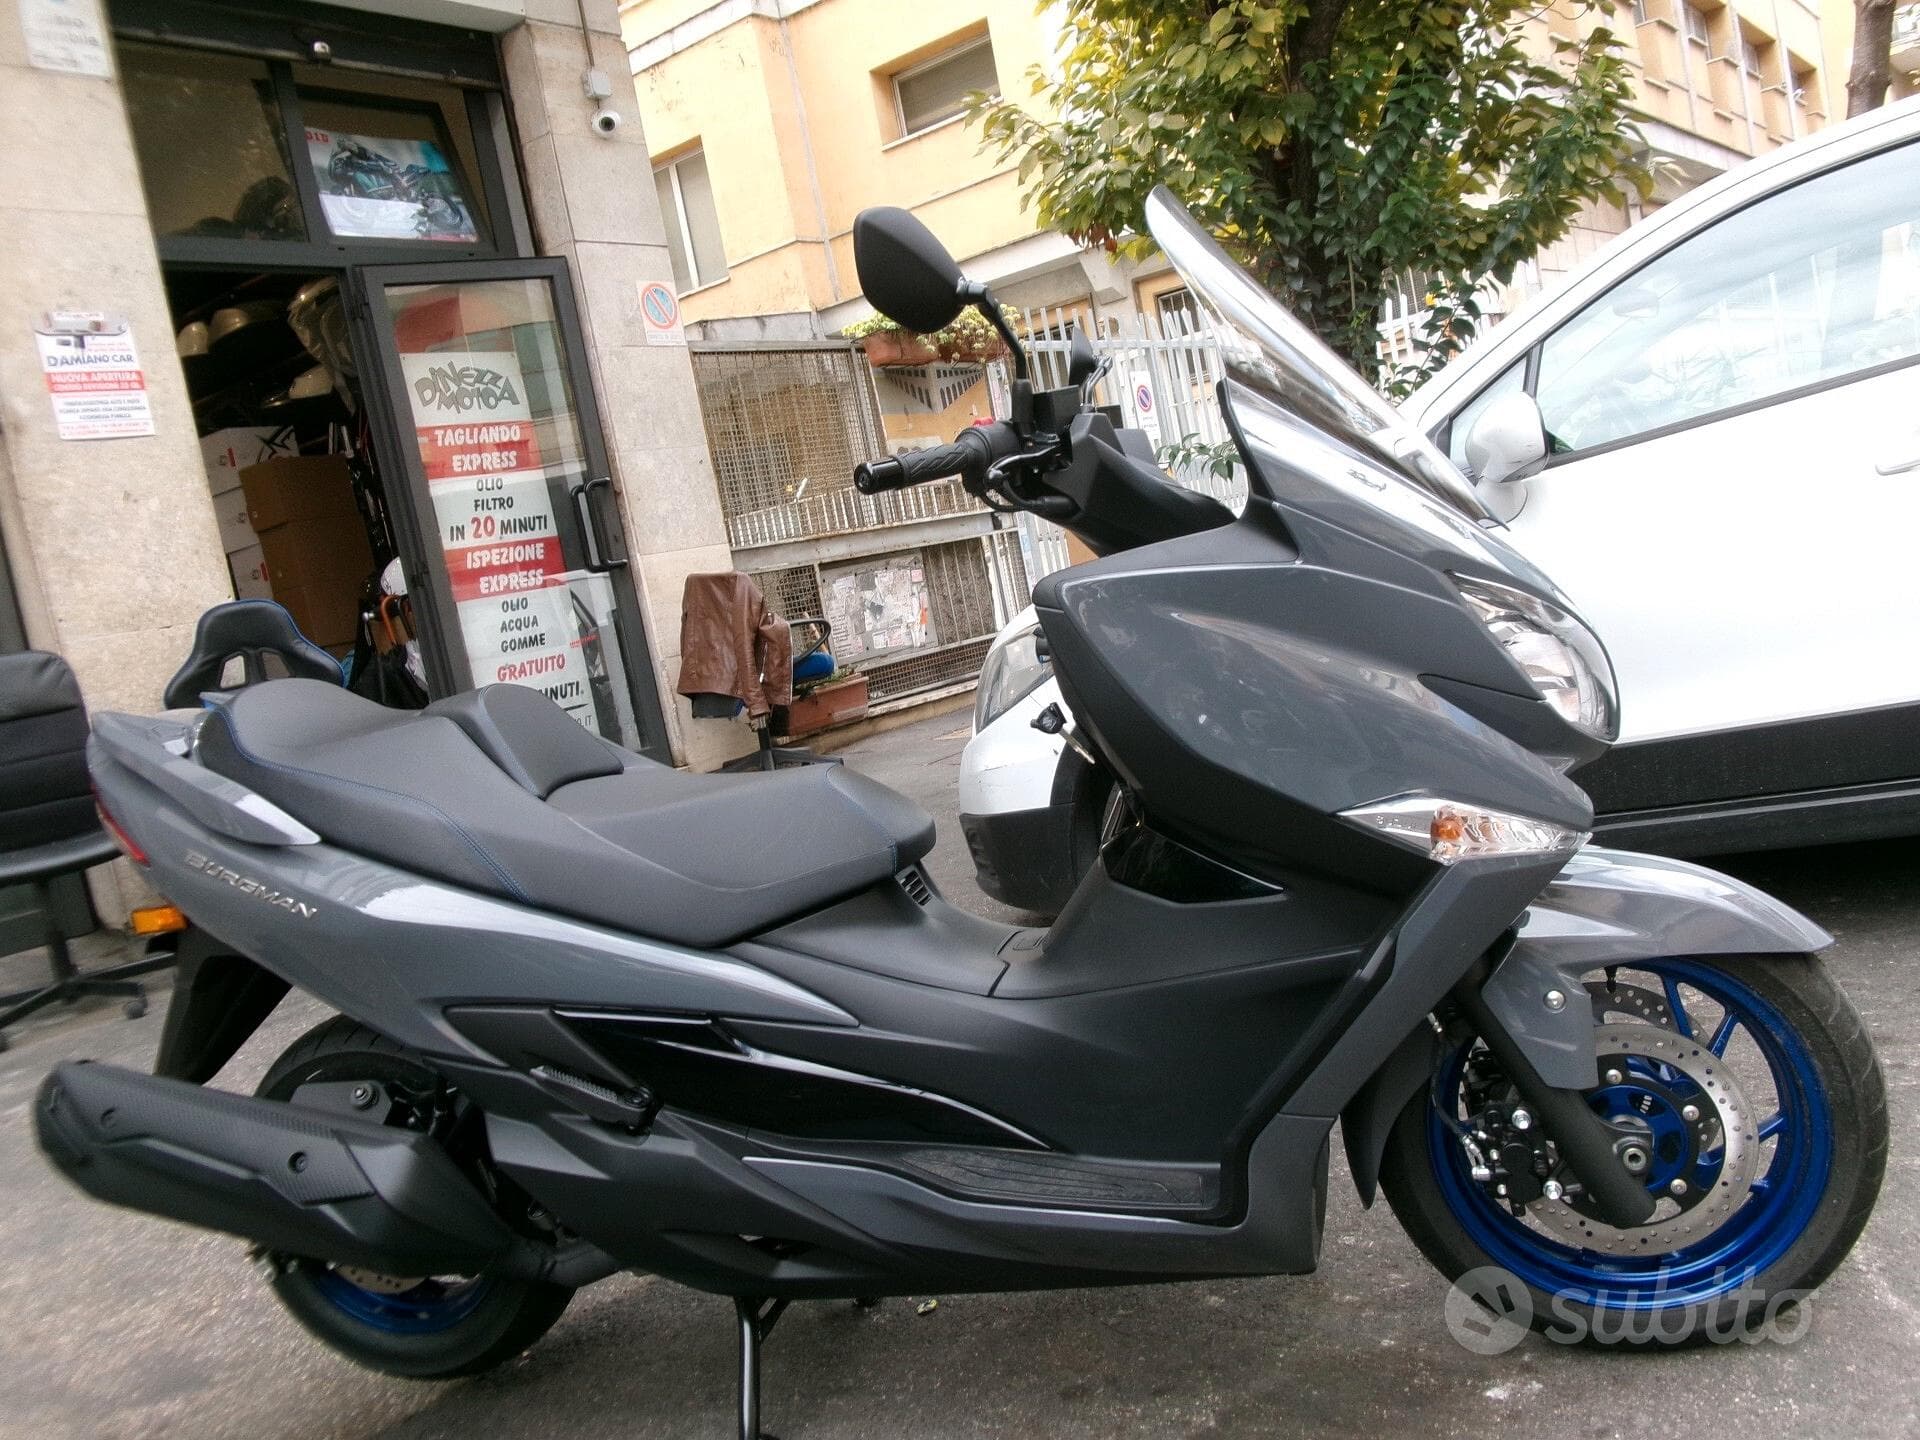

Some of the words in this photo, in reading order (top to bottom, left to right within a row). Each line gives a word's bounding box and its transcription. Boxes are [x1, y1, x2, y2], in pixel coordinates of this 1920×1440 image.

[47, 354, 110, 367] DAMIANO
[112, 354, 134, 363] CAR
[434, 424, 521, 447] TAGLIANDO
[452, 450, 518, 472] EXPRESS
[476, 478, 503, 492] OLIO
[474, 496, 514, 512] FILTRO
[450, 525, 465, 542] IN
[471, 515, 495, 539] 20
[500, 514, 548, 535] MINUTI
[466, 543, 544, 569] ISPEZIONE
[479, 569, 544, 594] EXPRESS
[501, 597, 529, 613] OLIO
[500, 615, 539, 633] ACQUA
[501, 633, 546, 653] GOMME
[497, 653, 566, 682] GRATUITO
[184, 850, 318, 919] BURGMAN
